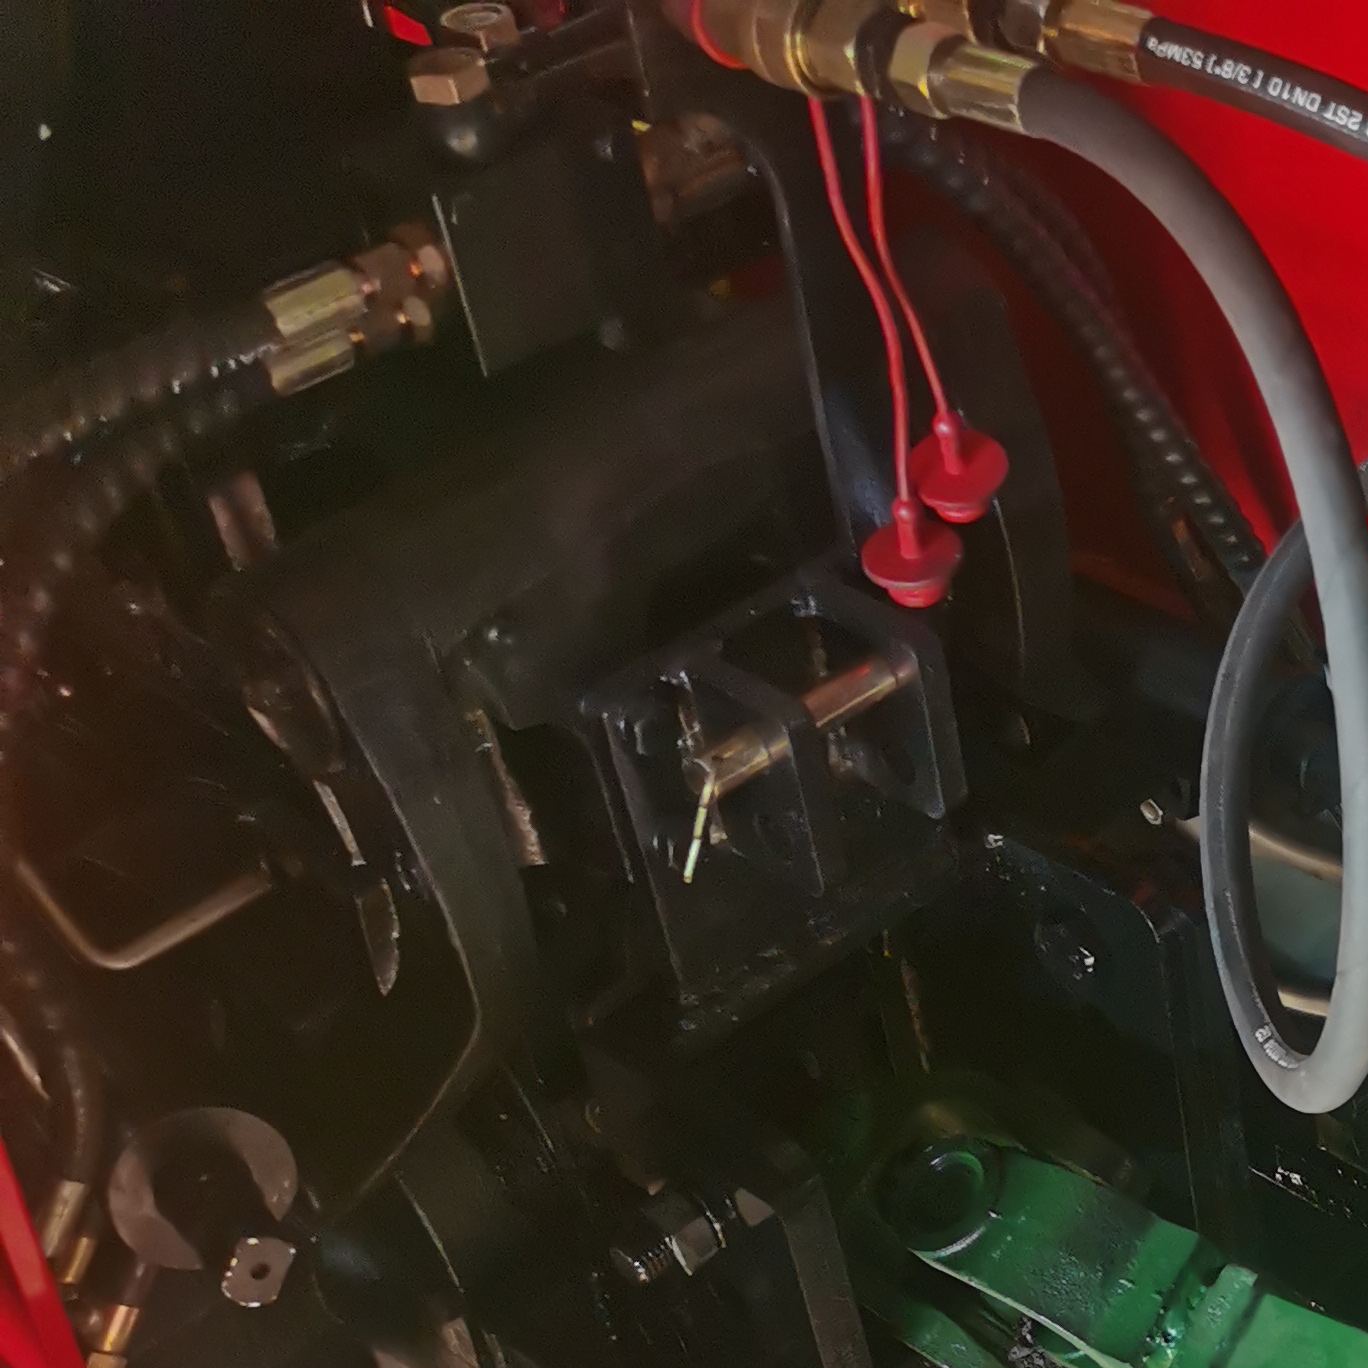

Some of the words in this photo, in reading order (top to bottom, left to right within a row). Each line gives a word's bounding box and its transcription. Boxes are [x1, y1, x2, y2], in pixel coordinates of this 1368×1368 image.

[1147, 35, 1204, 70] 53MPa
[1267, 77, 1322, 112] DN10
[1322, 101, 1363, 131] 2ST
